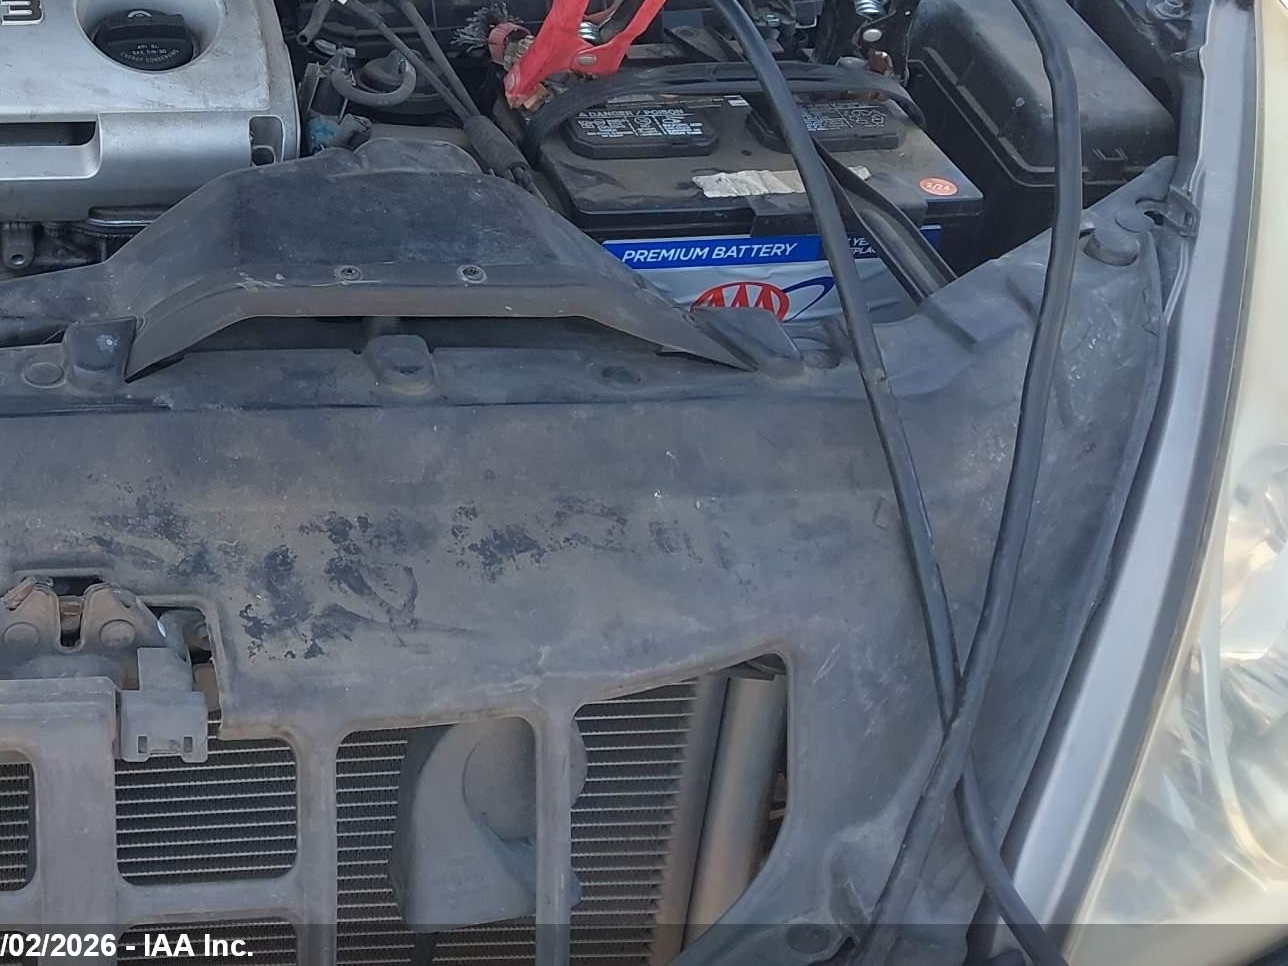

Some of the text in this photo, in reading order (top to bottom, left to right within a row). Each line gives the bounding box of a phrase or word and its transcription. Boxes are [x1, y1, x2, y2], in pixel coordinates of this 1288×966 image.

[643, 108, 685, 117] POISON
[621, 242, 799, 264] PREMIUM BATTERY
